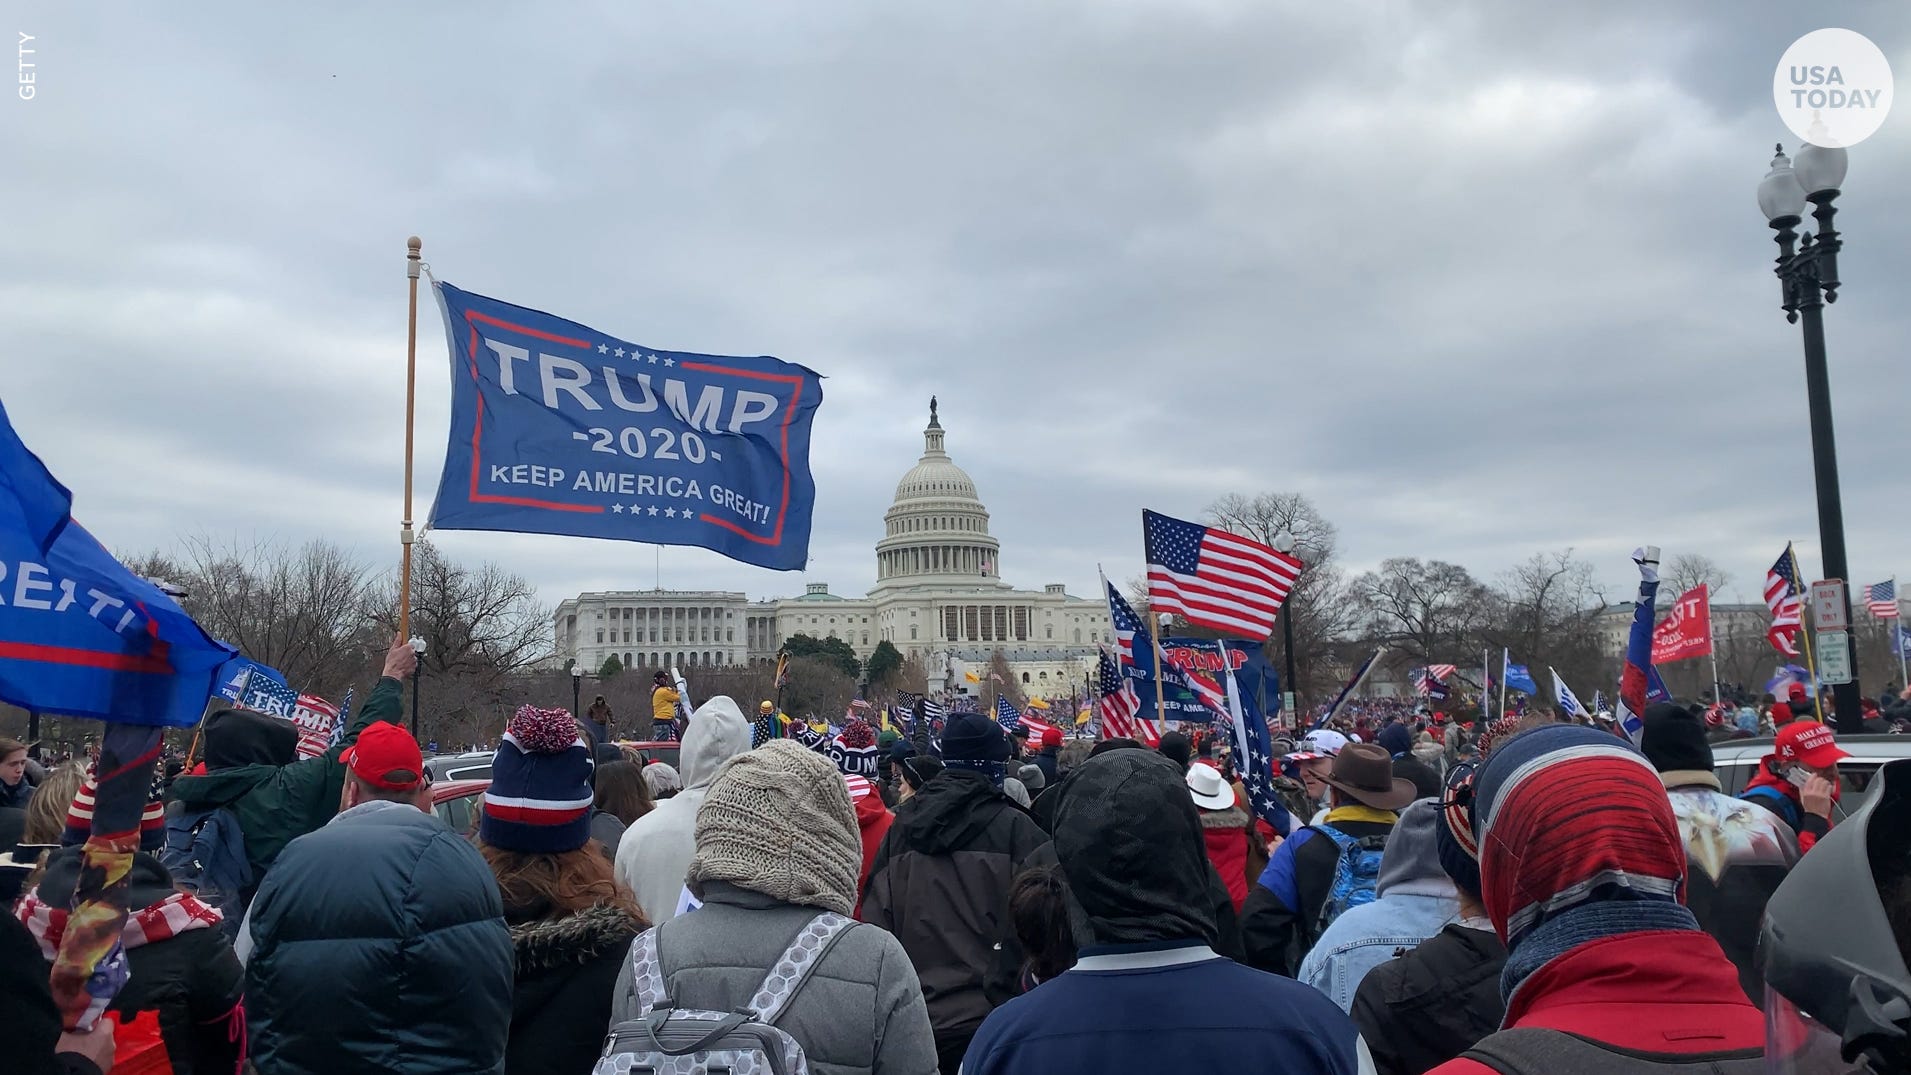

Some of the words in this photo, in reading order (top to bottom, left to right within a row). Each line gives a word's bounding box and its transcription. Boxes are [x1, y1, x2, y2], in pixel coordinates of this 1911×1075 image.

[484, 337, 779, 435] TRUMP
[572, 426, 723, 465] -2020-
[490, 464, 566, 488] KEEP
[572, 470, 703, 500] AMERICA
[709, 484, 771, 525] GREAT!
[252, 690, 331, 733] TRUMP
[1782, 744, 1795, 757] 45
[1795, 730, 1815, 742] MAKE
[1804, 736, 1825, 749] GREAT
[824, 744, 880, 774] RUM
